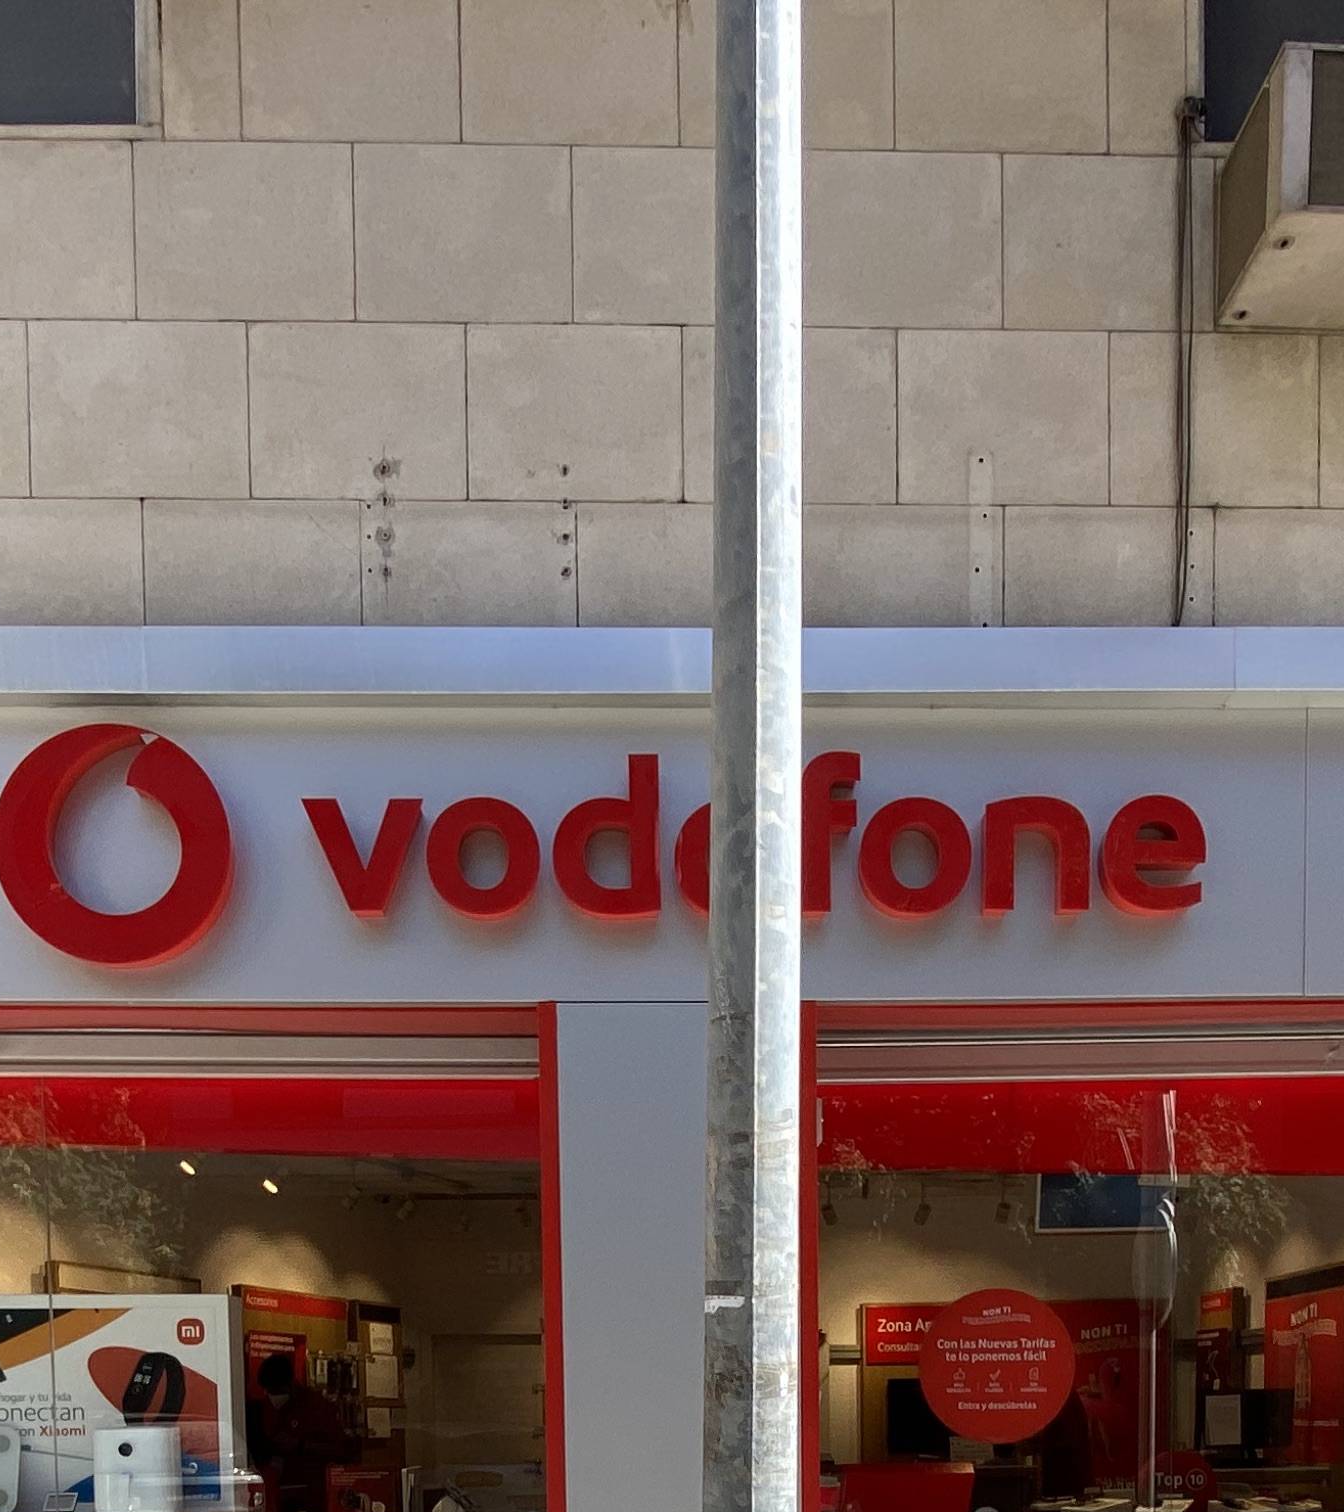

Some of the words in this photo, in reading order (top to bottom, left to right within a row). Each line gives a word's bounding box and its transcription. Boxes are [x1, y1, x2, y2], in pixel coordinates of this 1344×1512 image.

[877, 1318, 912, 1333] Zona
[937, 1338, 957, 1350] Con
[959, 1338, 976, 1349] las
[978, 1338, 1018, 1349] Nuevas
[1020, 1337, 1056, 1349] Tarifas
[945, 1351, 957, 1361] te
[959, 1351, 970, 1361] lo
[971, 1352, 1021, 1363] ponemos
[1023, 1349, 1047, 1361] fácil
[29, 1394, 37, 1404] y
[38, 1393, 49, 1402] tu
[51, 1393, 72, 1402] ida
[1155, 1471, 1182, 1489] Top
[1190, 1473, 1204, 1486] 10
